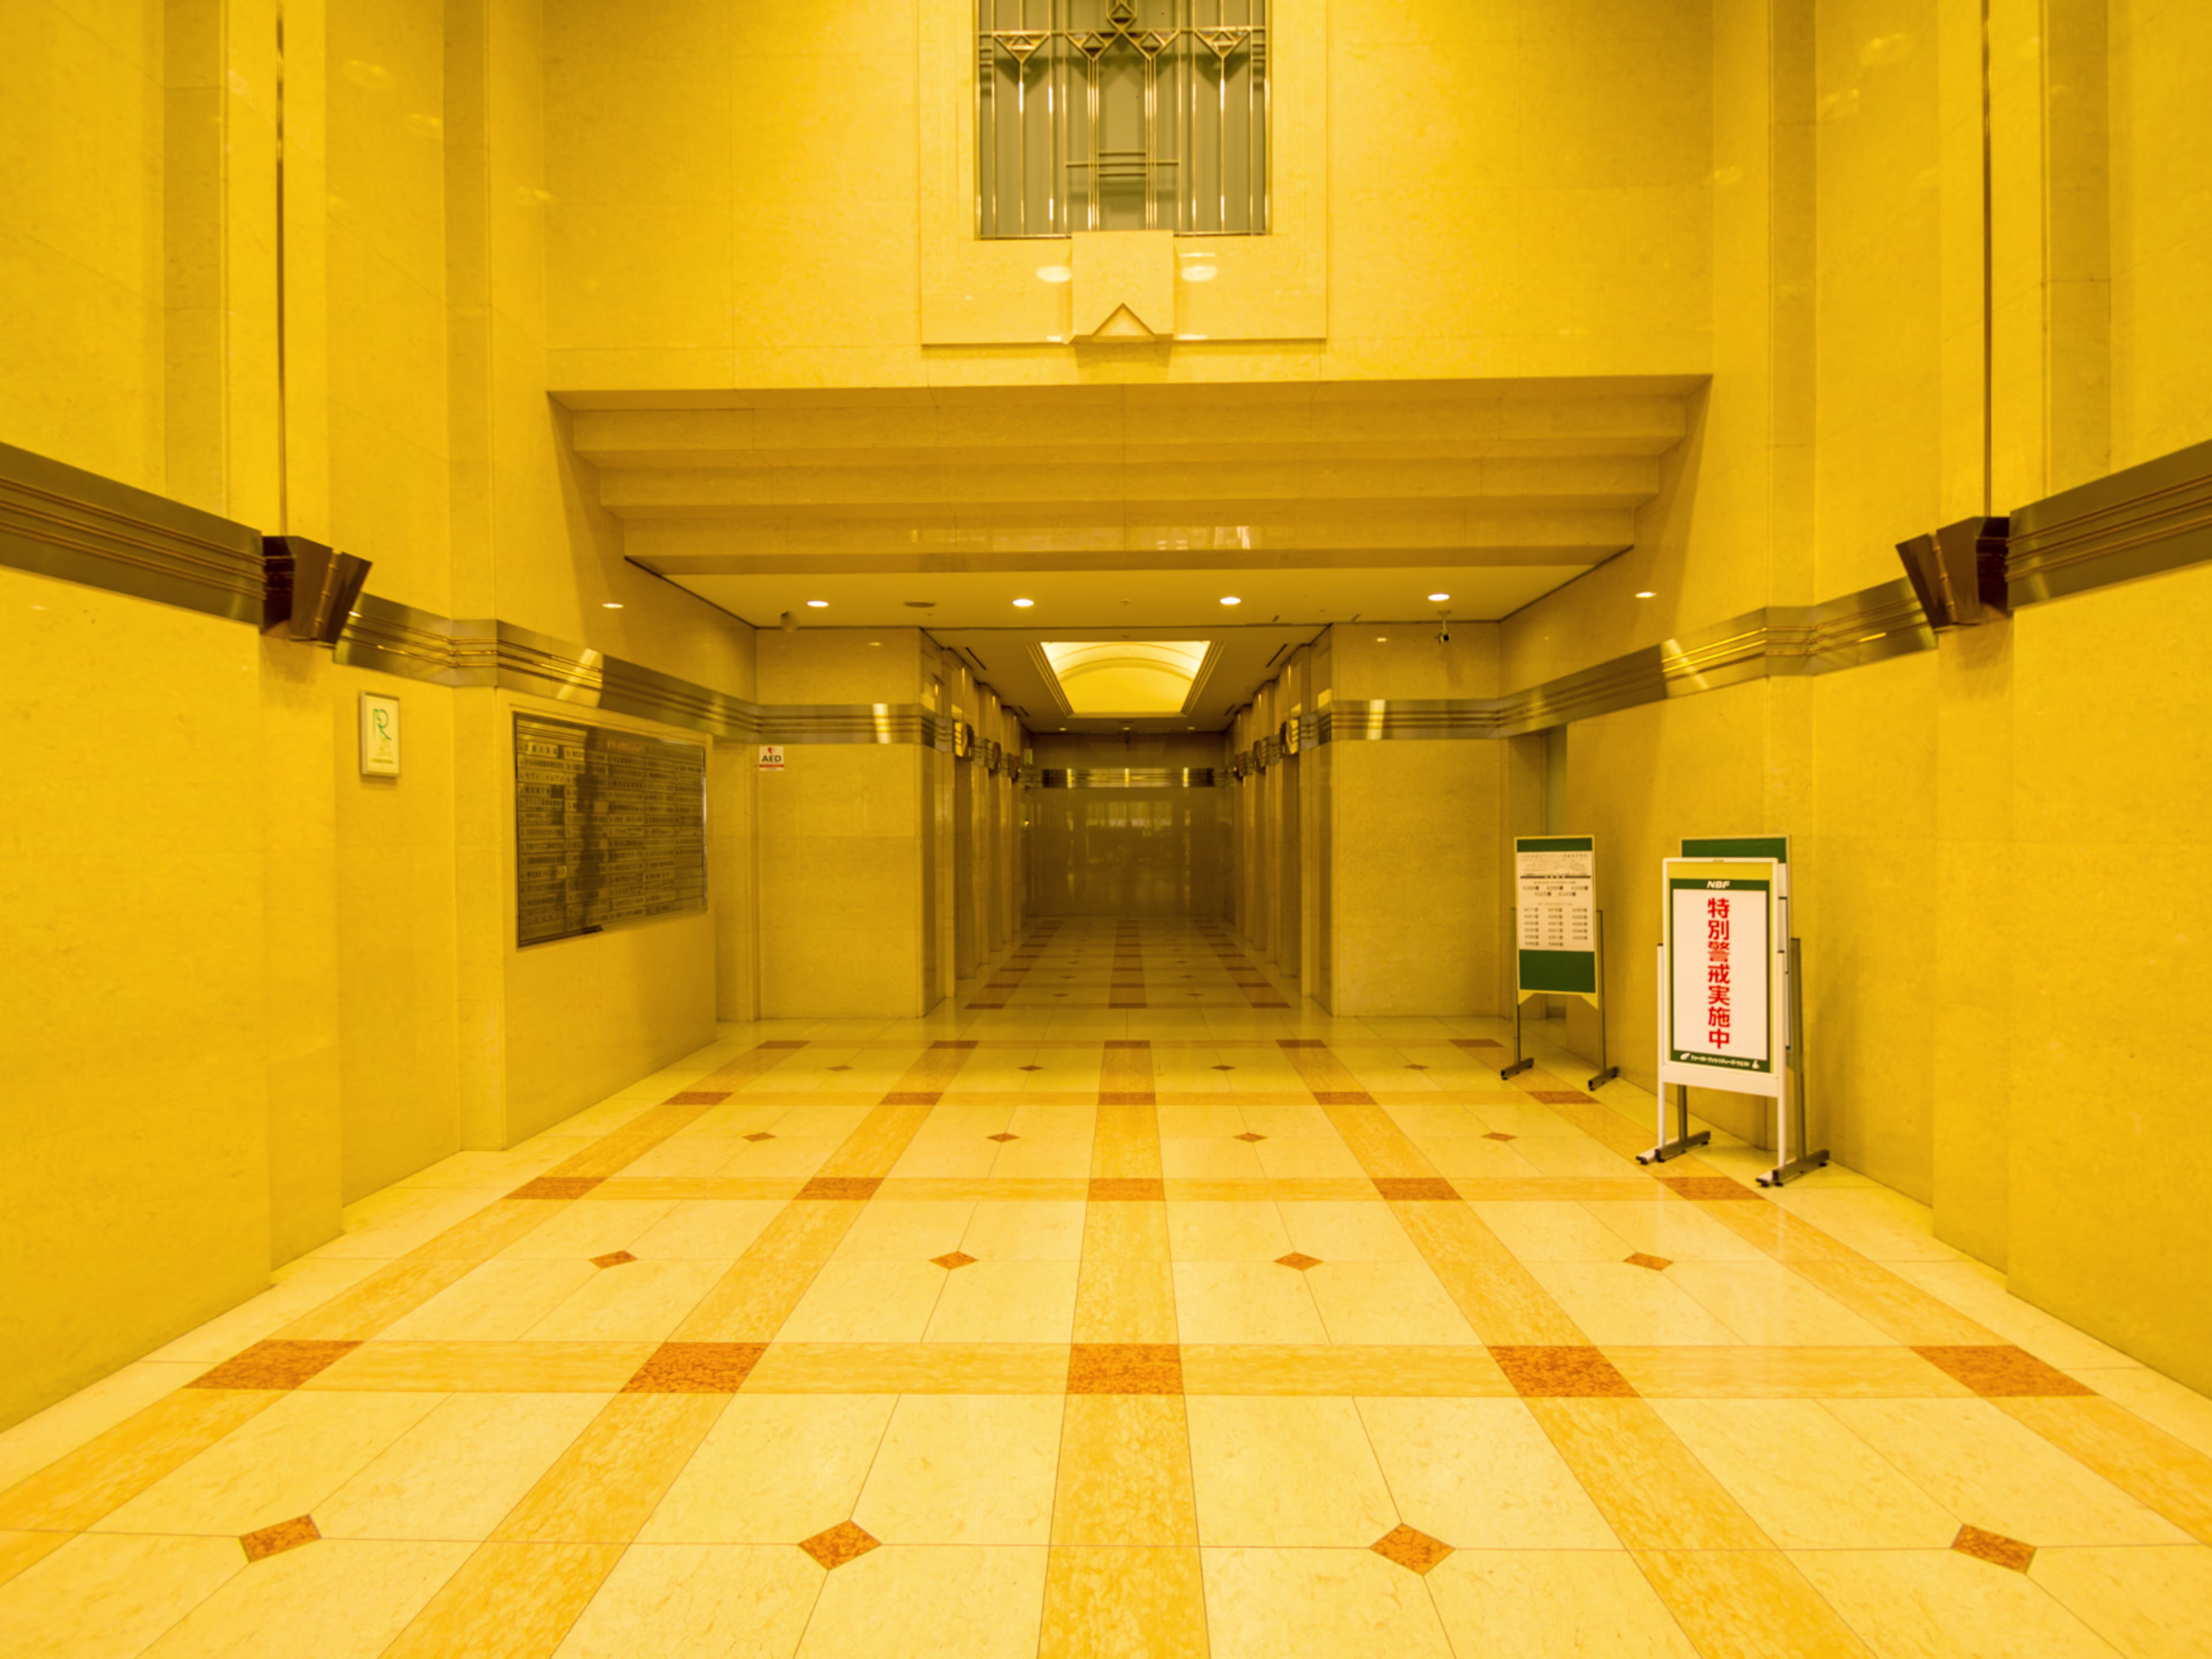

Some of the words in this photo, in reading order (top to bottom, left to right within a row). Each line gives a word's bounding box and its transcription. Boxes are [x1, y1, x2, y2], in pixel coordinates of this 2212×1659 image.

[762, 755, 782, 763] AED
[1706, 880, 1730, 889] NBF
[1707, 897, 1730, 1050] 特別警戒実施中
